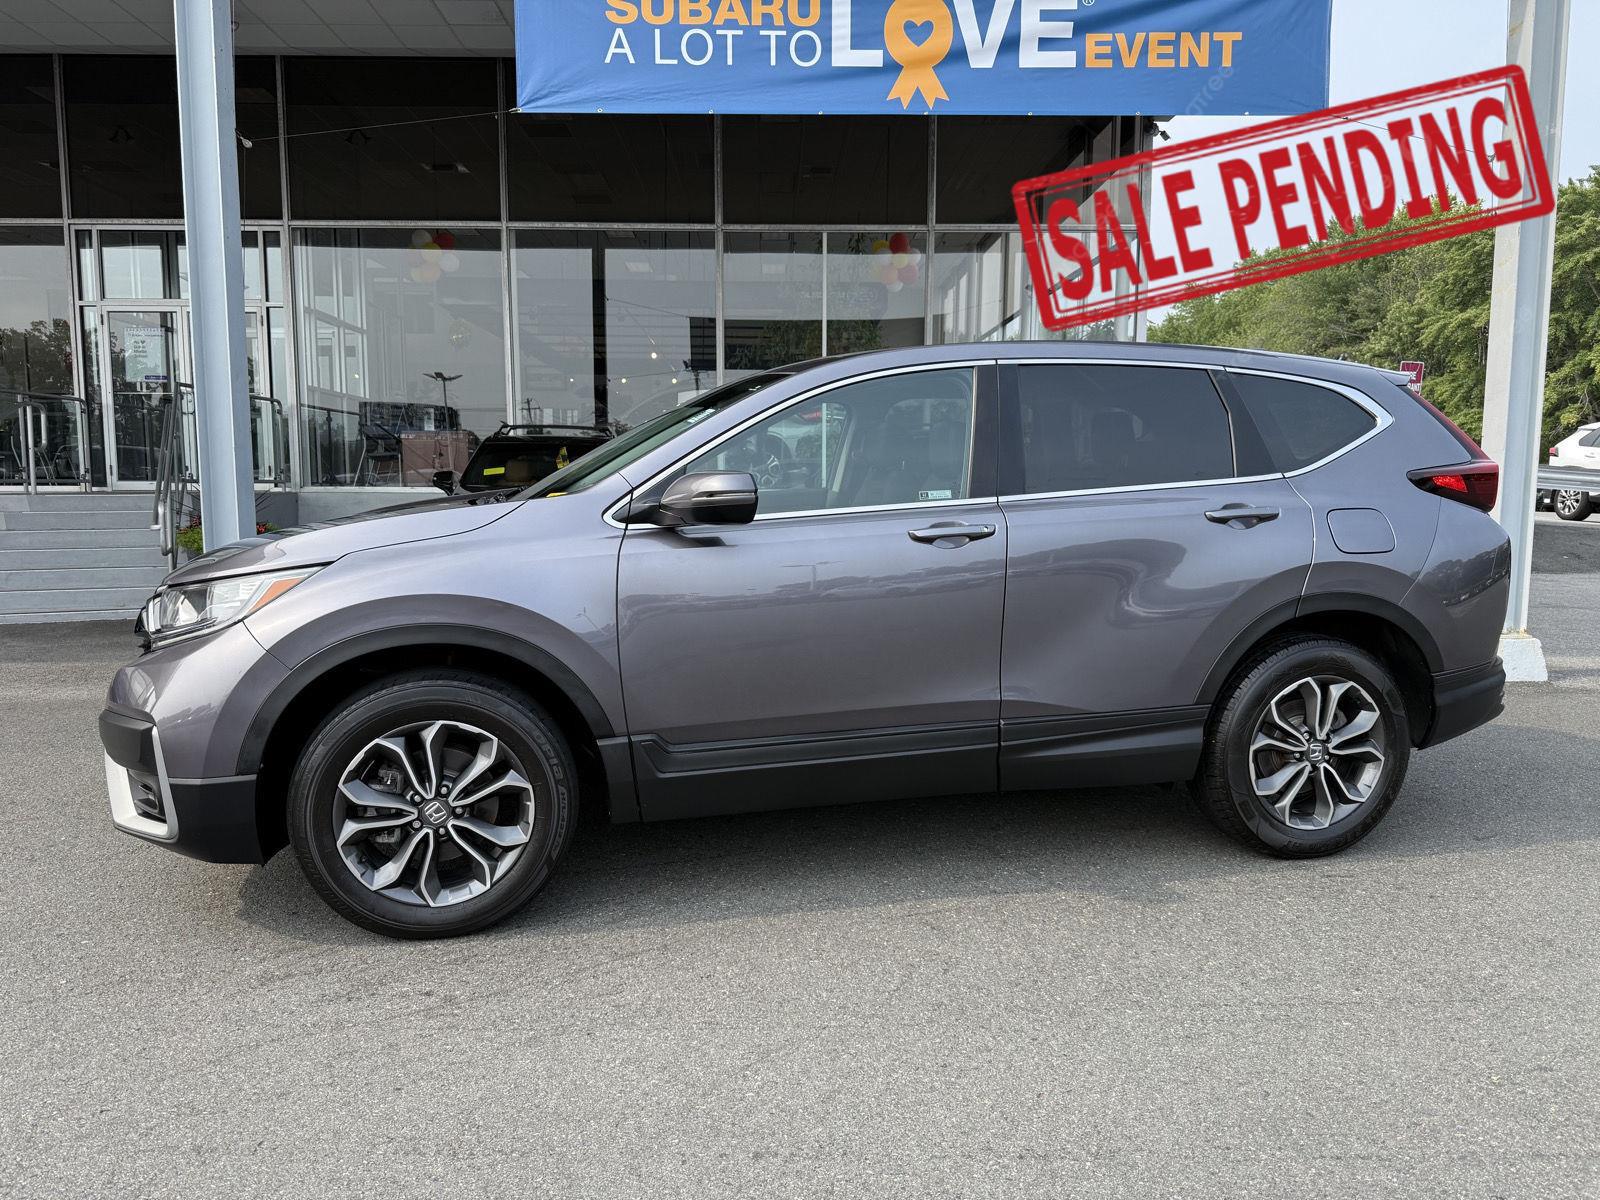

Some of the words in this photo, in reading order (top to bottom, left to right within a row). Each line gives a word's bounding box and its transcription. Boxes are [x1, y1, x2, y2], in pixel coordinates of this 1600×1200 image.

[604, 0, 821, 27] SUBARU
[604, 27, 636, 64] A
[654, 28, 744, 66] LOT
[760, 29, 822, 68] TO
[831, 0, 1078, 71] LOVE
[1084, 31, 1243, 68] EVENT
